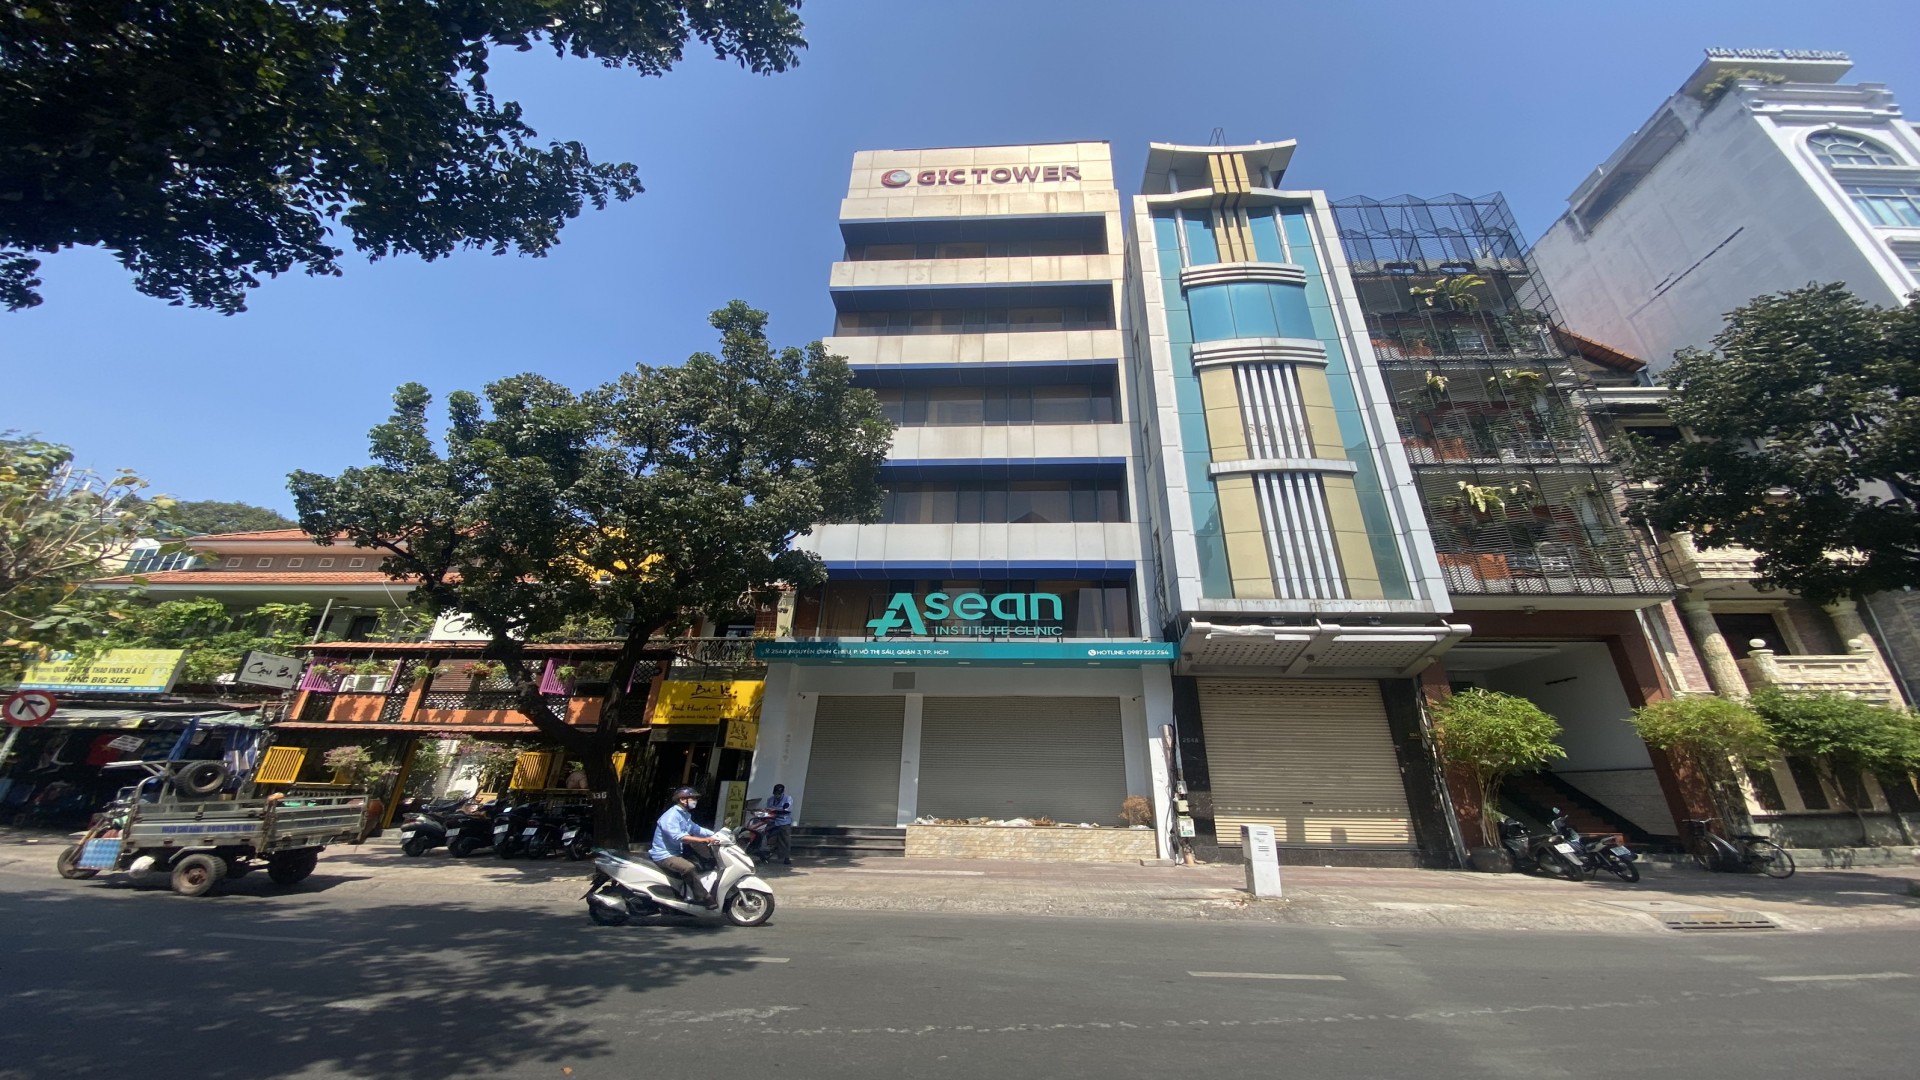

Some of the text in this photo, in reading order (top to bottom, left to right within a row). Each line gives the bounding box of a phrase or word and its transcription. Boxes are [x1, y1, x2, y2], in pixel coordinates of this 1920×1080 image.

[1780, 49, 1850, 61] BUILDING
[917, 164, 1082, 186] GIC TOWER
[935, 625, 1063, 636] INSTITUTE CLINIC
[91, 676, 108, 684] BIG
[109, 676, 131, 684] SIZE
